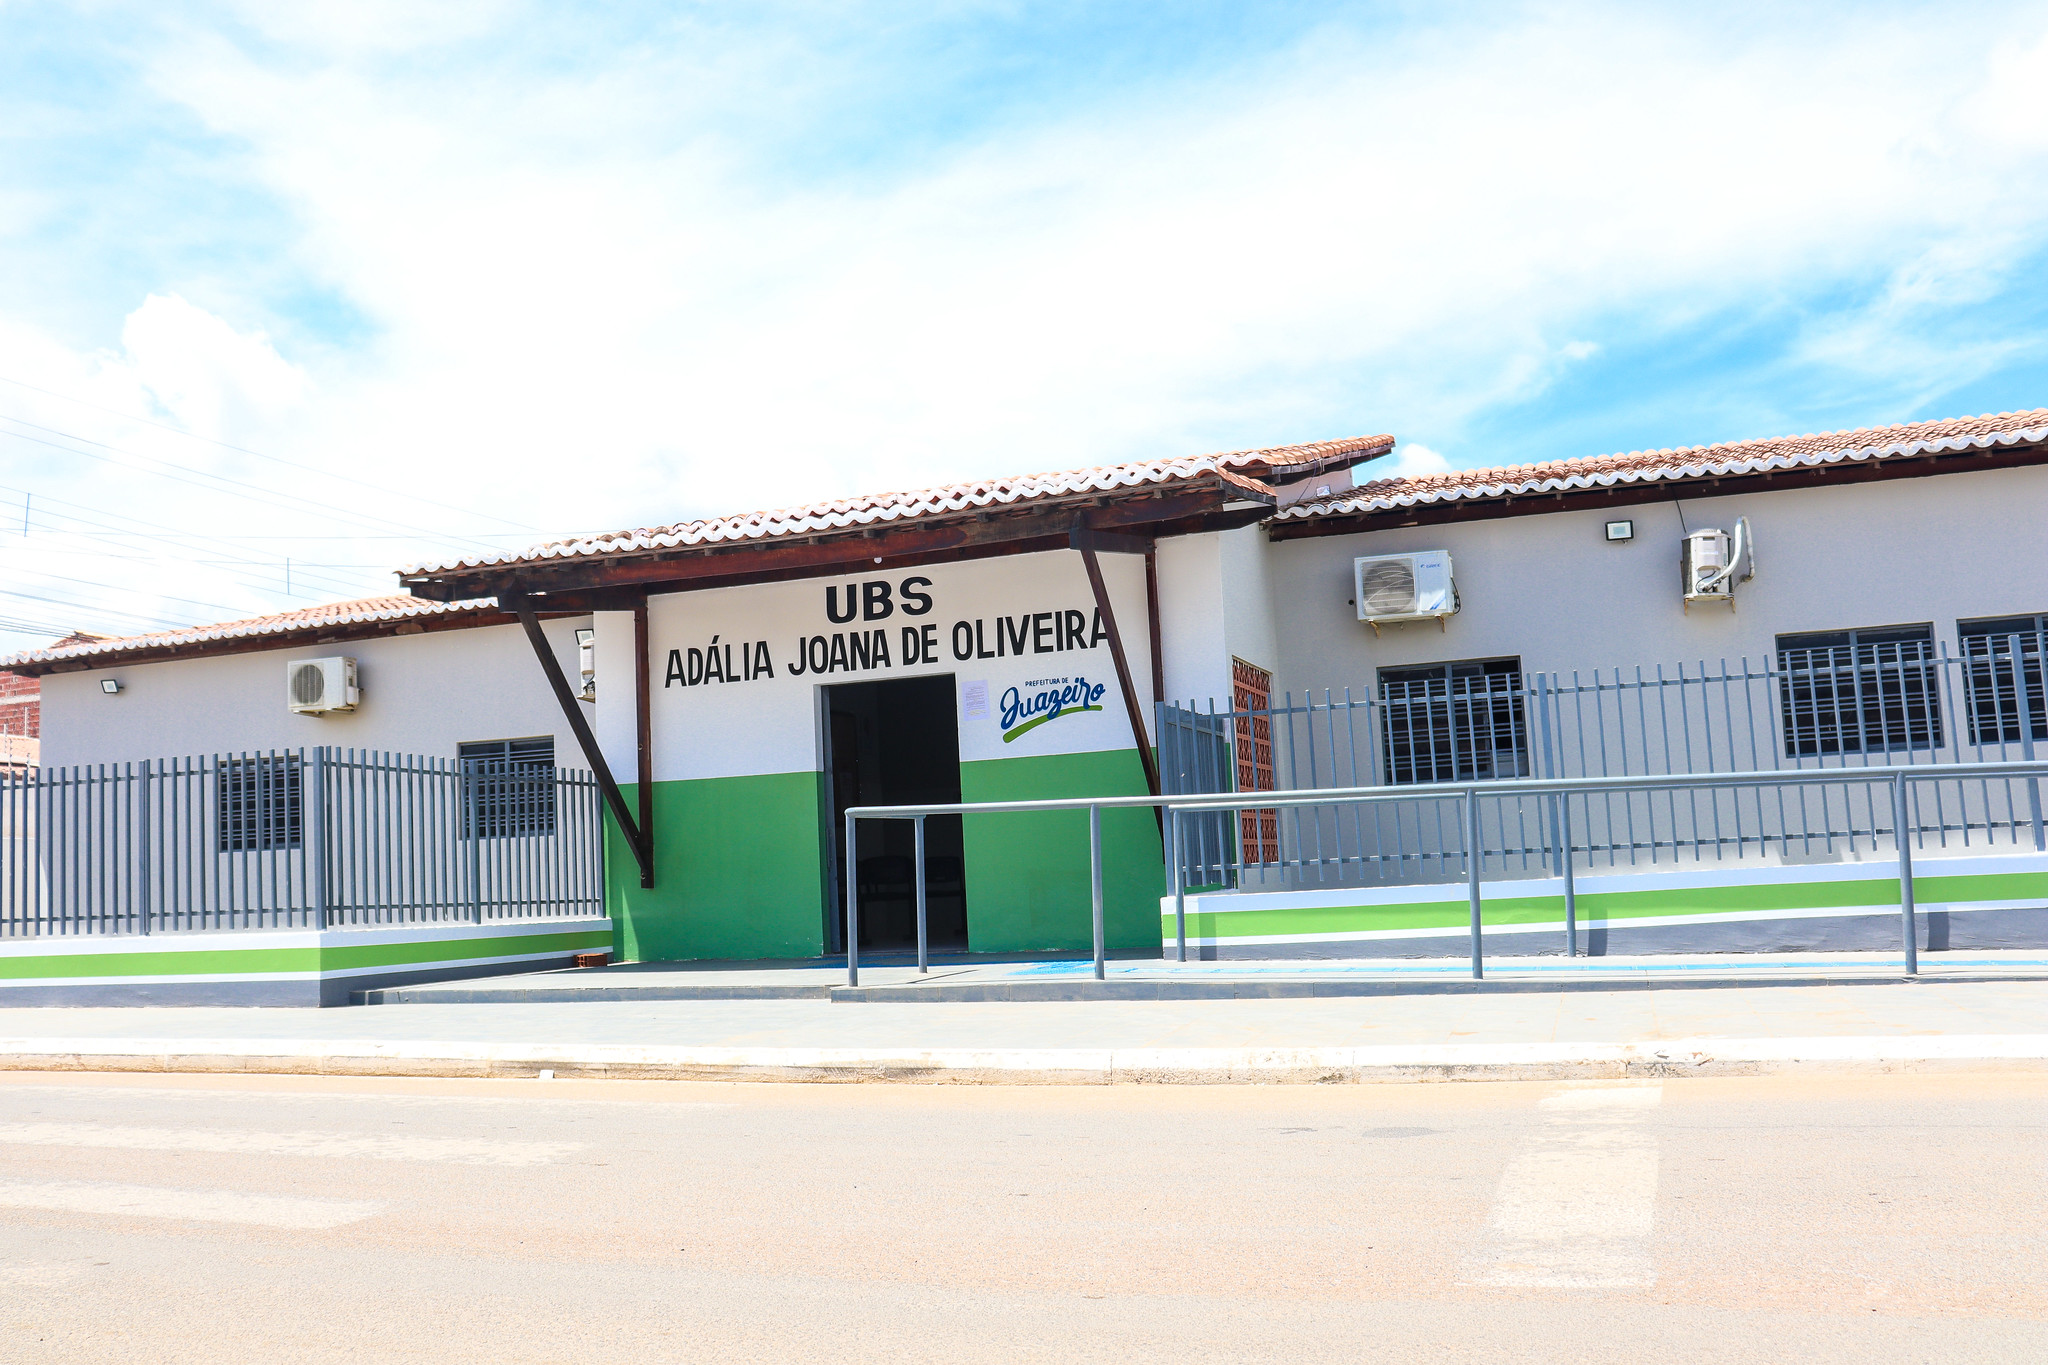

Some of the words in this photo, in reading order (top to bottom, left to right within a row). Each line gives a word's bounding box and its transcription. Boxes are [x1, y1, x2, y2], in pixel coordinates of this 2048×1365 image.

[825, 576, 934, 624] UBS
[664, 634, 775, 689] ADÁLIA
[787, 628, 892, 676] JOANA
[901, 623, 939, 666] DE
[952, 606, 1109, 661] OLIVEIRA
[1000, 676, 1106, 730] Juazeiro
[1024, 677, 1061, 687] PREFEITURA
[1061, 676, 1069, 684] DE
